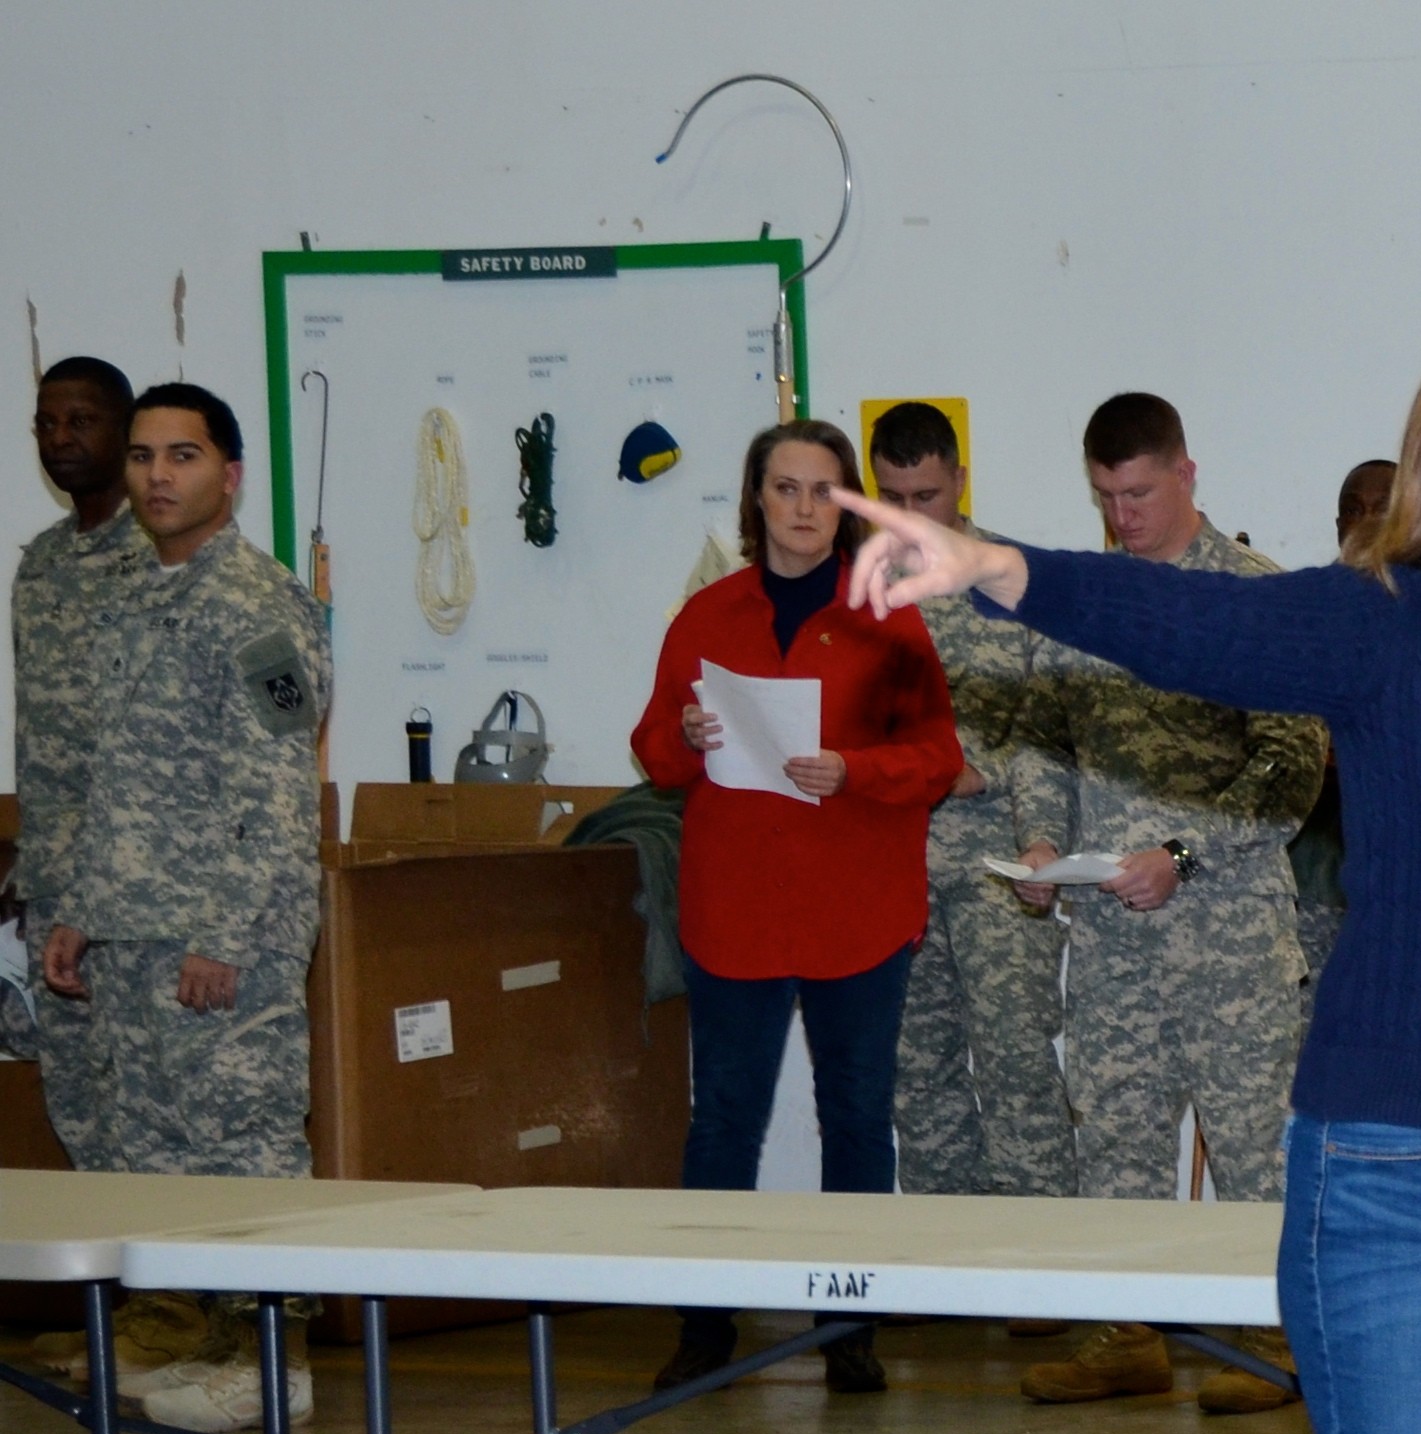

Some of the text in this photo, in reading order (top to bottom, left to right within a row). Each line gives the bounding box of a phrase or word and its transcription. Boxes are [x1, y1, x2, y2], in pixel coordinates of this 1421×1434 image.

[460, 255, 587, 272] SAFETY BOARD
[808, 1272, 875, 1298] FAAF
